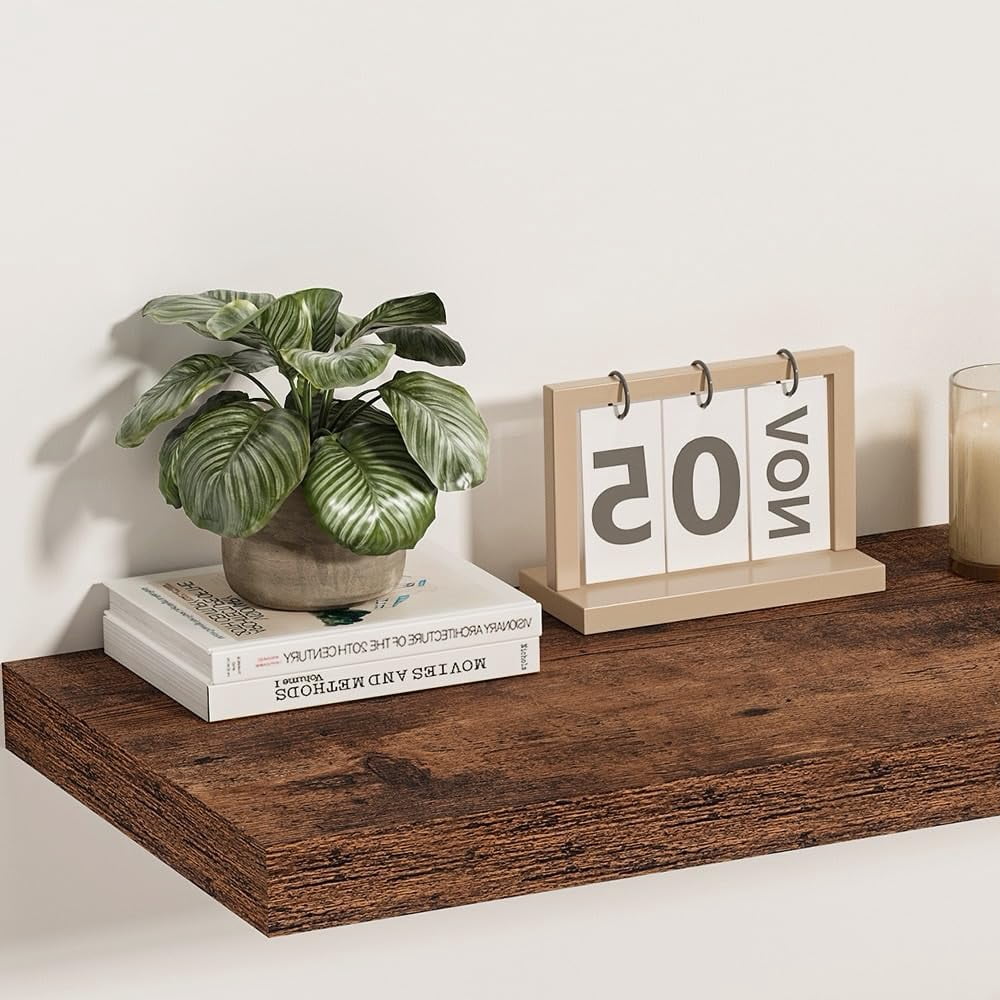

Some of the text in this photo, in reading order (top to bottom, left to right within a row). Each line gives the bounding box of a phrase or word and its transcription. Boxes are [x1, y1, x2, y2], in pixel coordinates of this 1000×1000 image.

[275, 657, 487, 701] MOVIES AND METHODS
[282, 673, 325, 685] Volume
